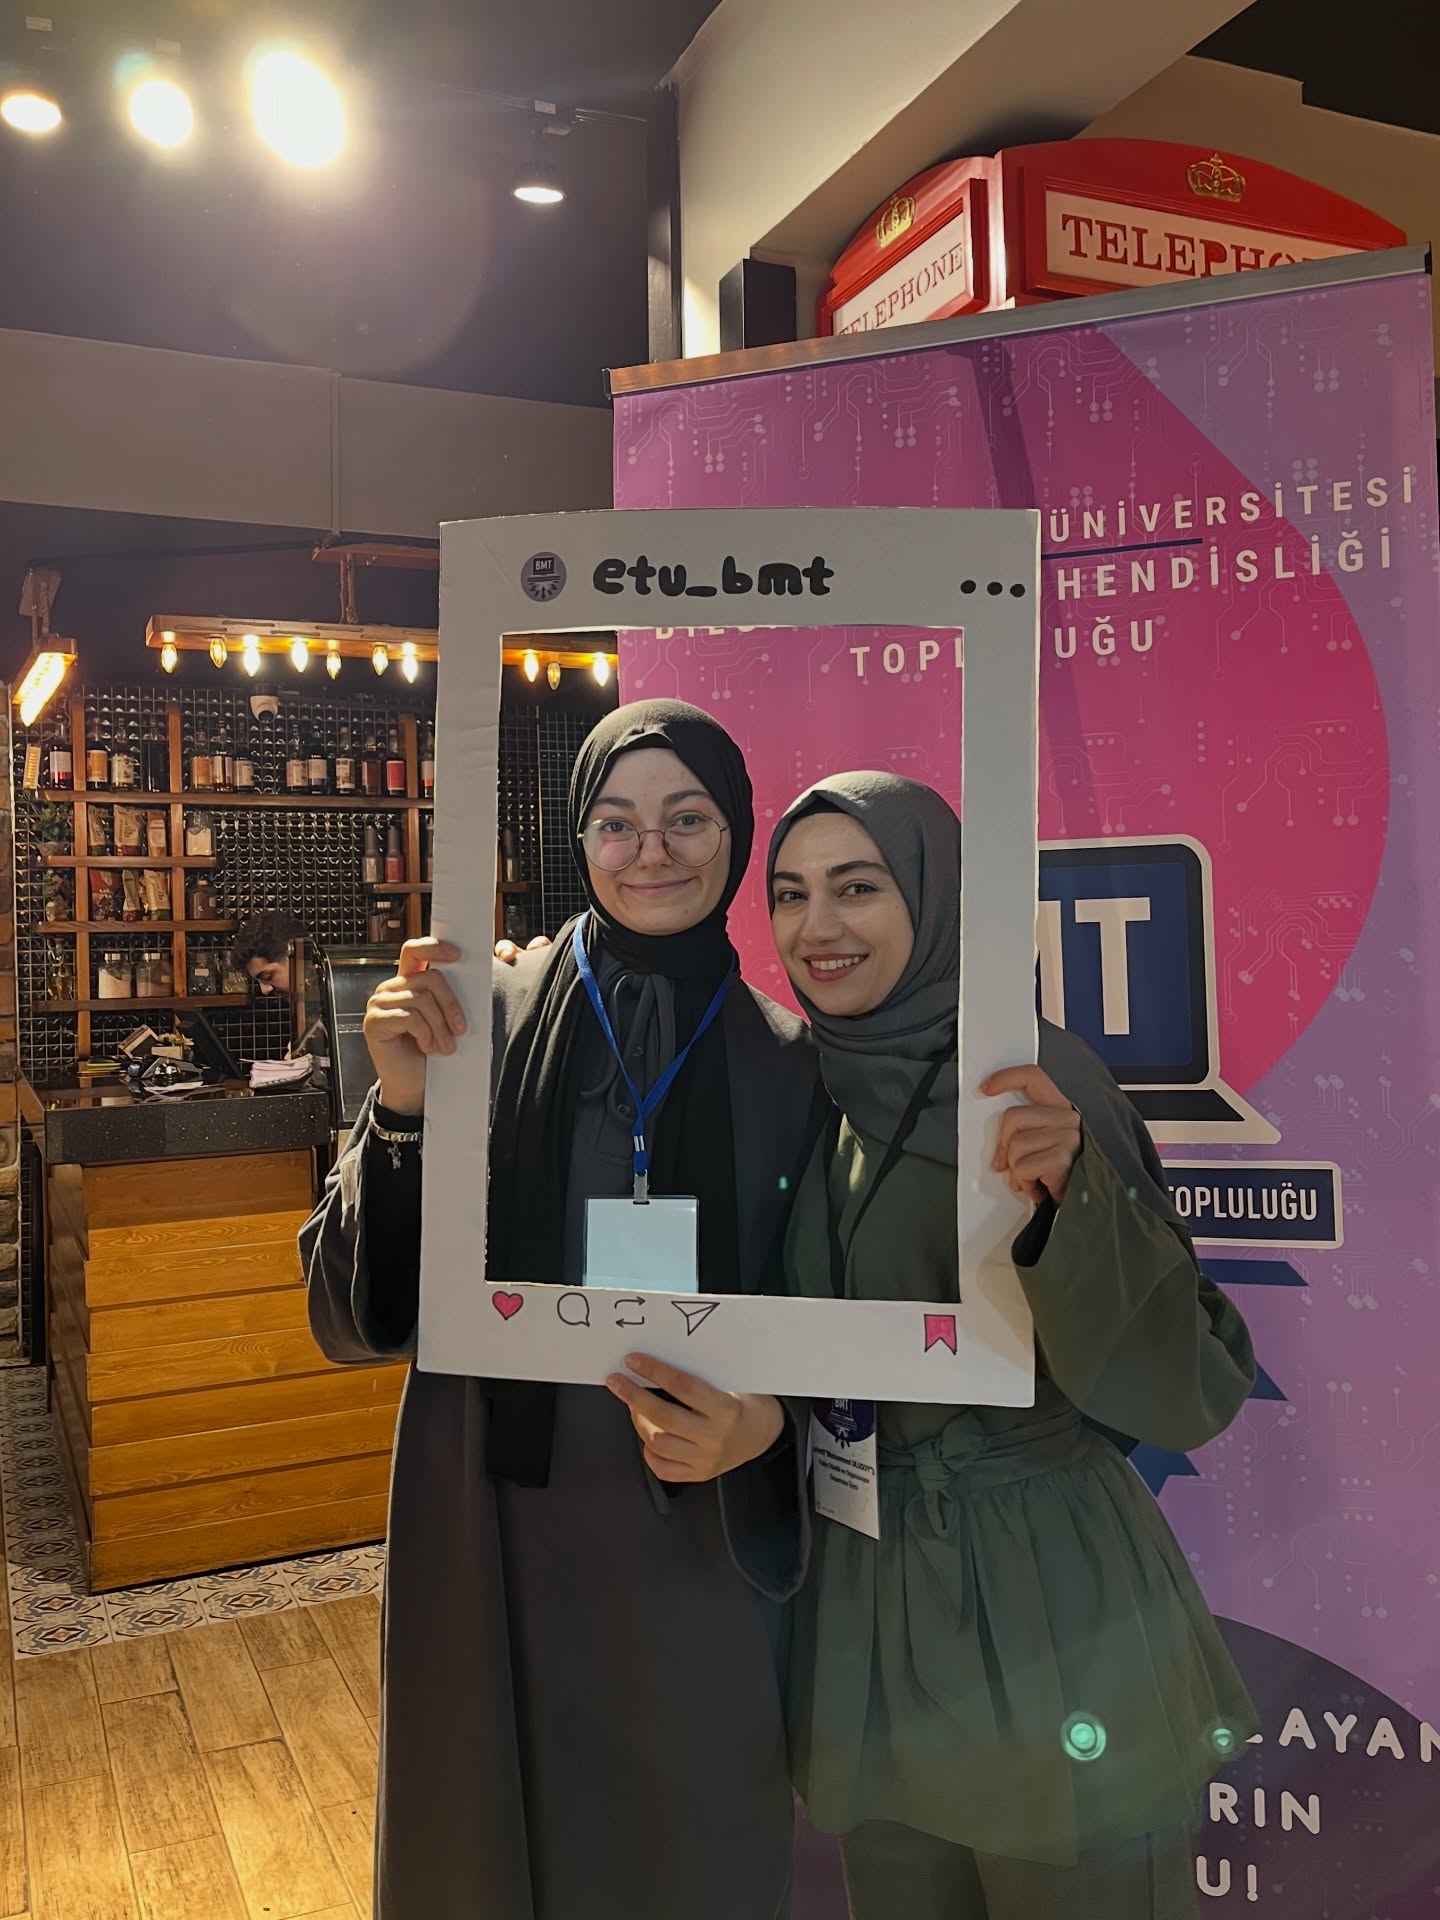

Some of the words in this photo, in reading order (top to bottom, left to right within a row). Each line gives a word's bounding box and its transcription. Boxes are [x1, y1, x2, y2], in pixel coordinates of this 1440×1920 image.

[1061, 213, 1315, 277] TELEPH
[1049, 467, 1412, 543] ÜNİVERSİTESİ
[535, 559, 552, 570] BMT
[593, 555, 834, 597] etu_bmt
[1057, 527, 1391, 600] HENDİSLİĞİ
[1168, 1181, 1317, 1220] OPLULUĞU
[1209, 1782, 1320, 1834] RIN
